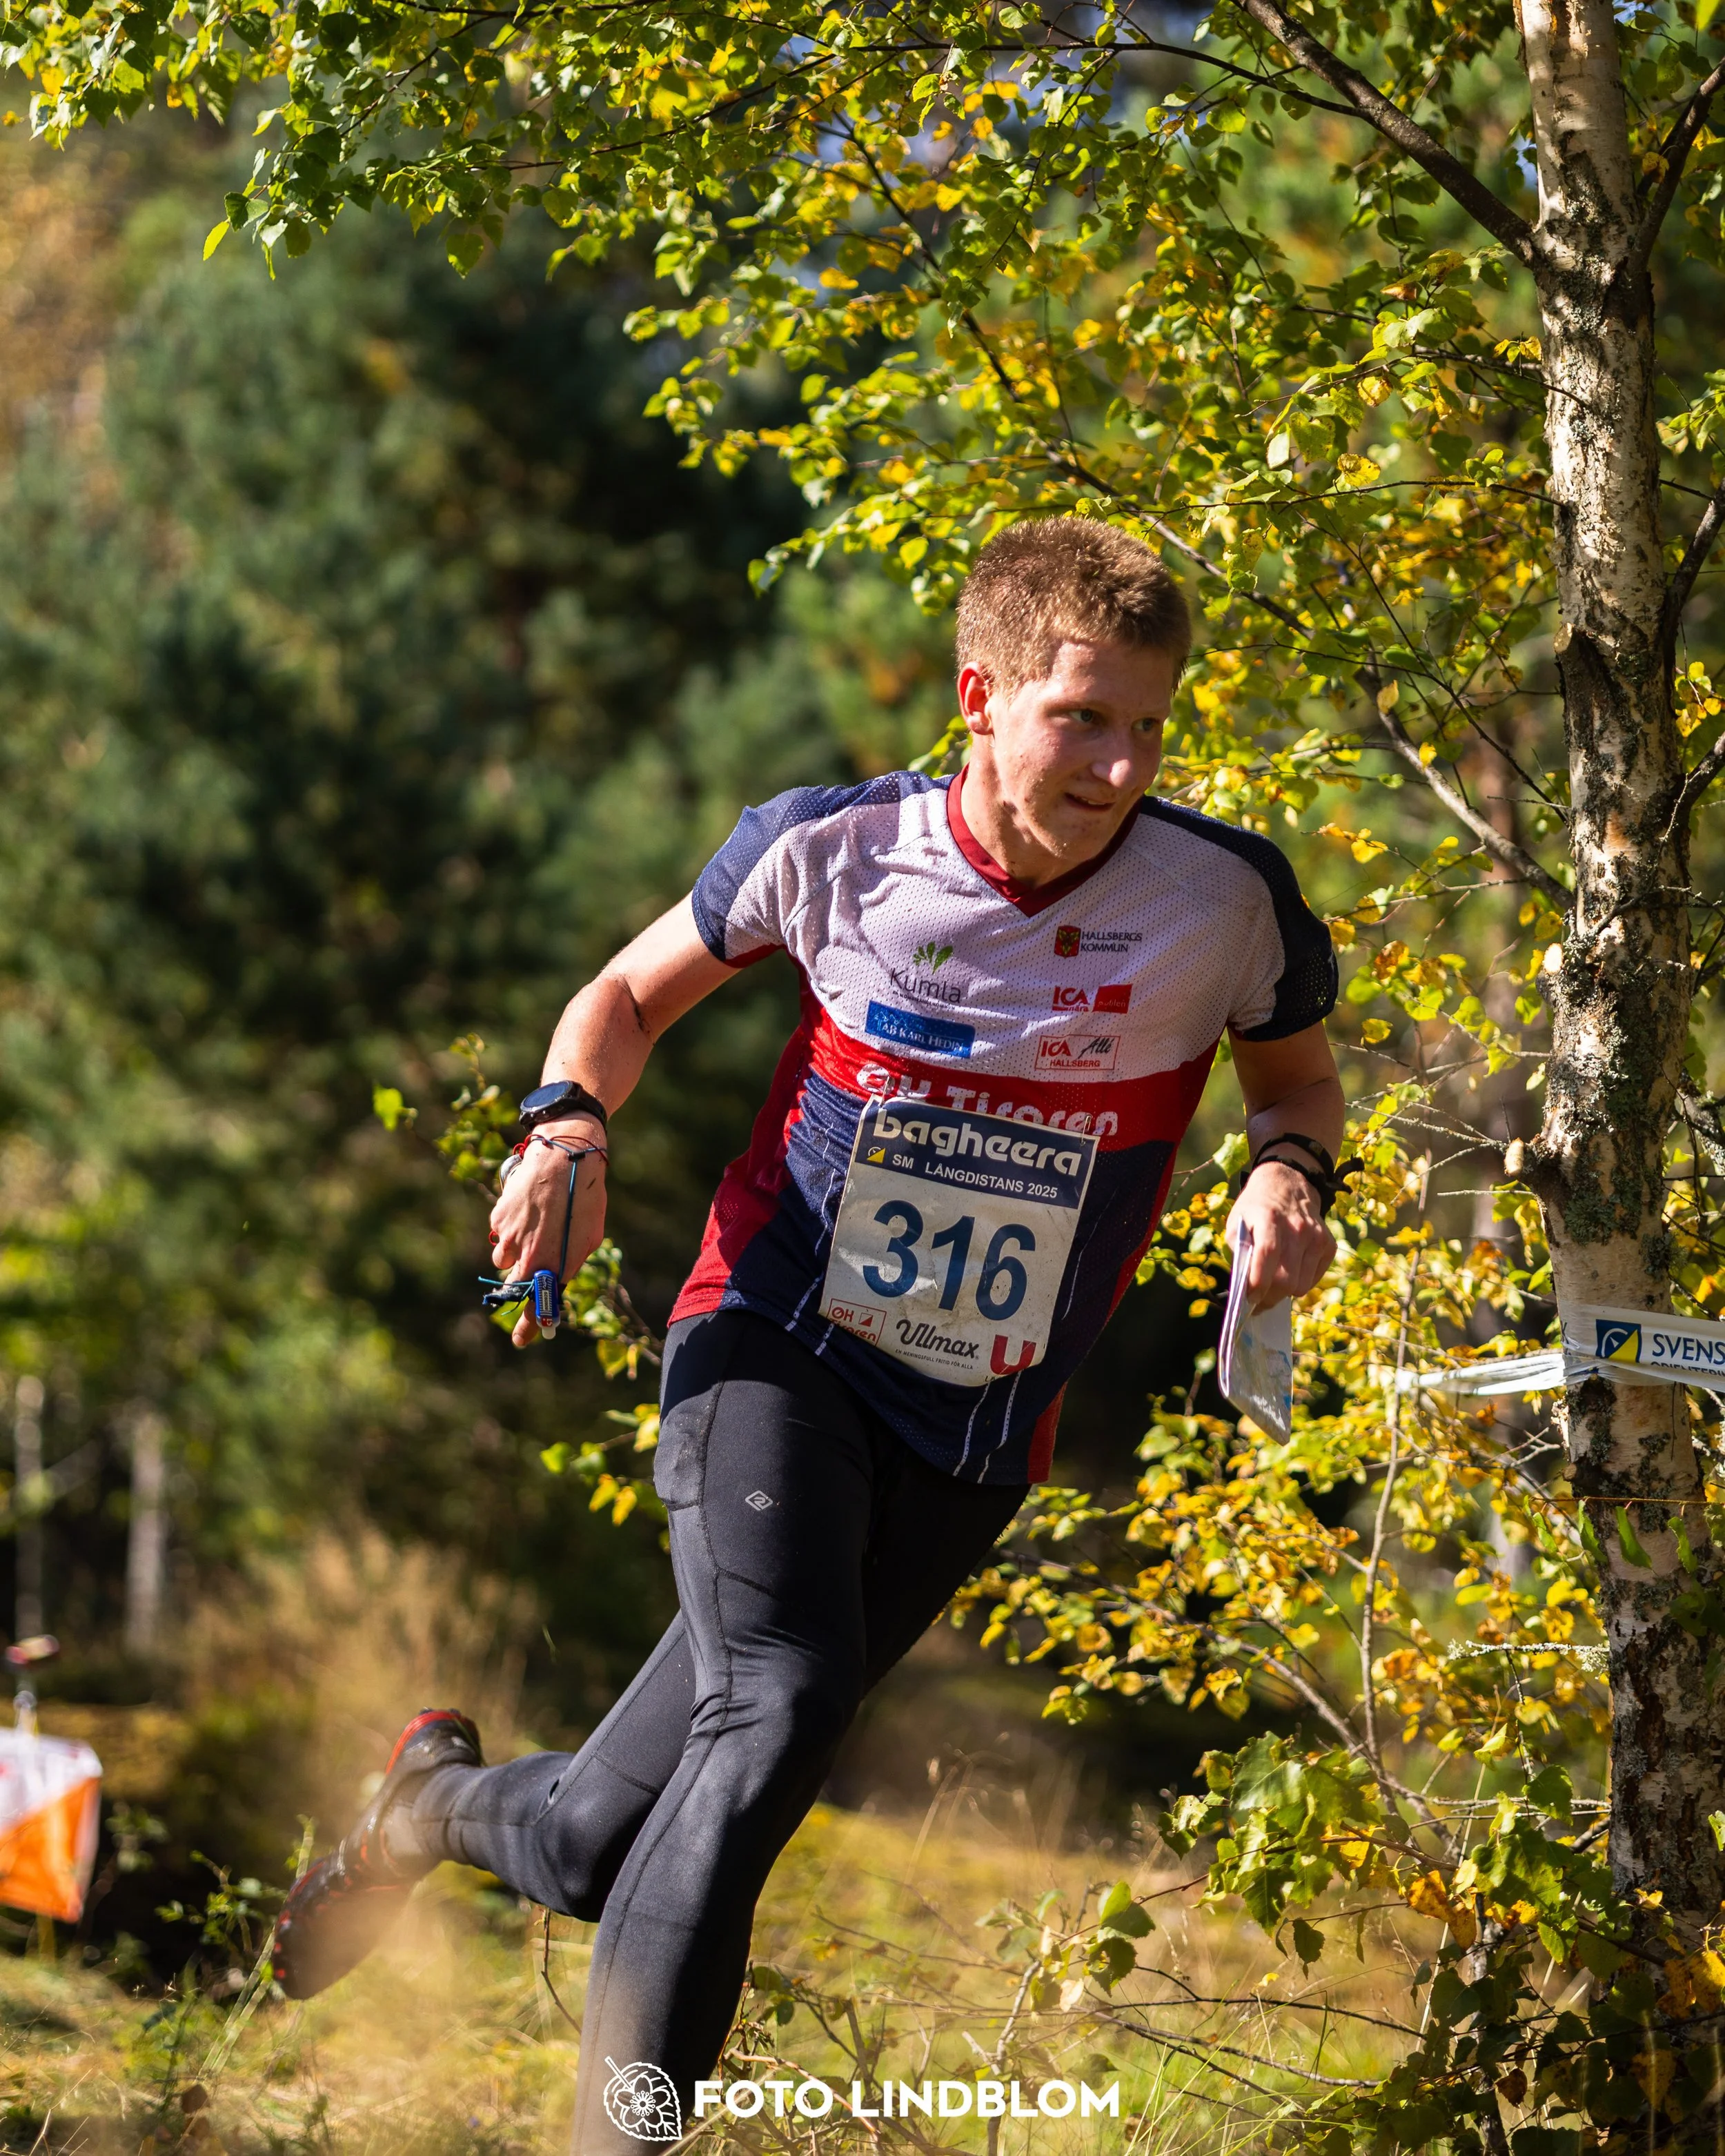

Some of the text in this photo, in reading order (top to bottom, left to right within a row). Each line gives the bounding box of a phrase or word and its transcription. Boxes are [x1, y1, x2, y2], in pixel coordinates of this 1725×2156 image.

[1081, 931, 1143, 942] HALLSBERGS
[1081, 943, 1129, 953] KOMMUN
[890, 967, 961, 1003] Kumla
[1052, 985, 1090, 1006] ICA
[882, 1022, 898, 1036] AB
[898, 1027, 926, 1044] KARL
[1041, 1039, 1072, 1057] ICA
[1049, 1059, 1101, 1067] HALLSBERG
[873, 1107, 1082, 1176] bagheera
[891, 1154, 1058, 1199] SM LÅNGDISTANS 2025
[862, 1199, 1036, 1321] 316
[896, 1318, 979, 1359] Ullmax
[1652, 1333, 1725, 1365] SVENS
[903, 1351, 934, 1362] MENINGSFULL
